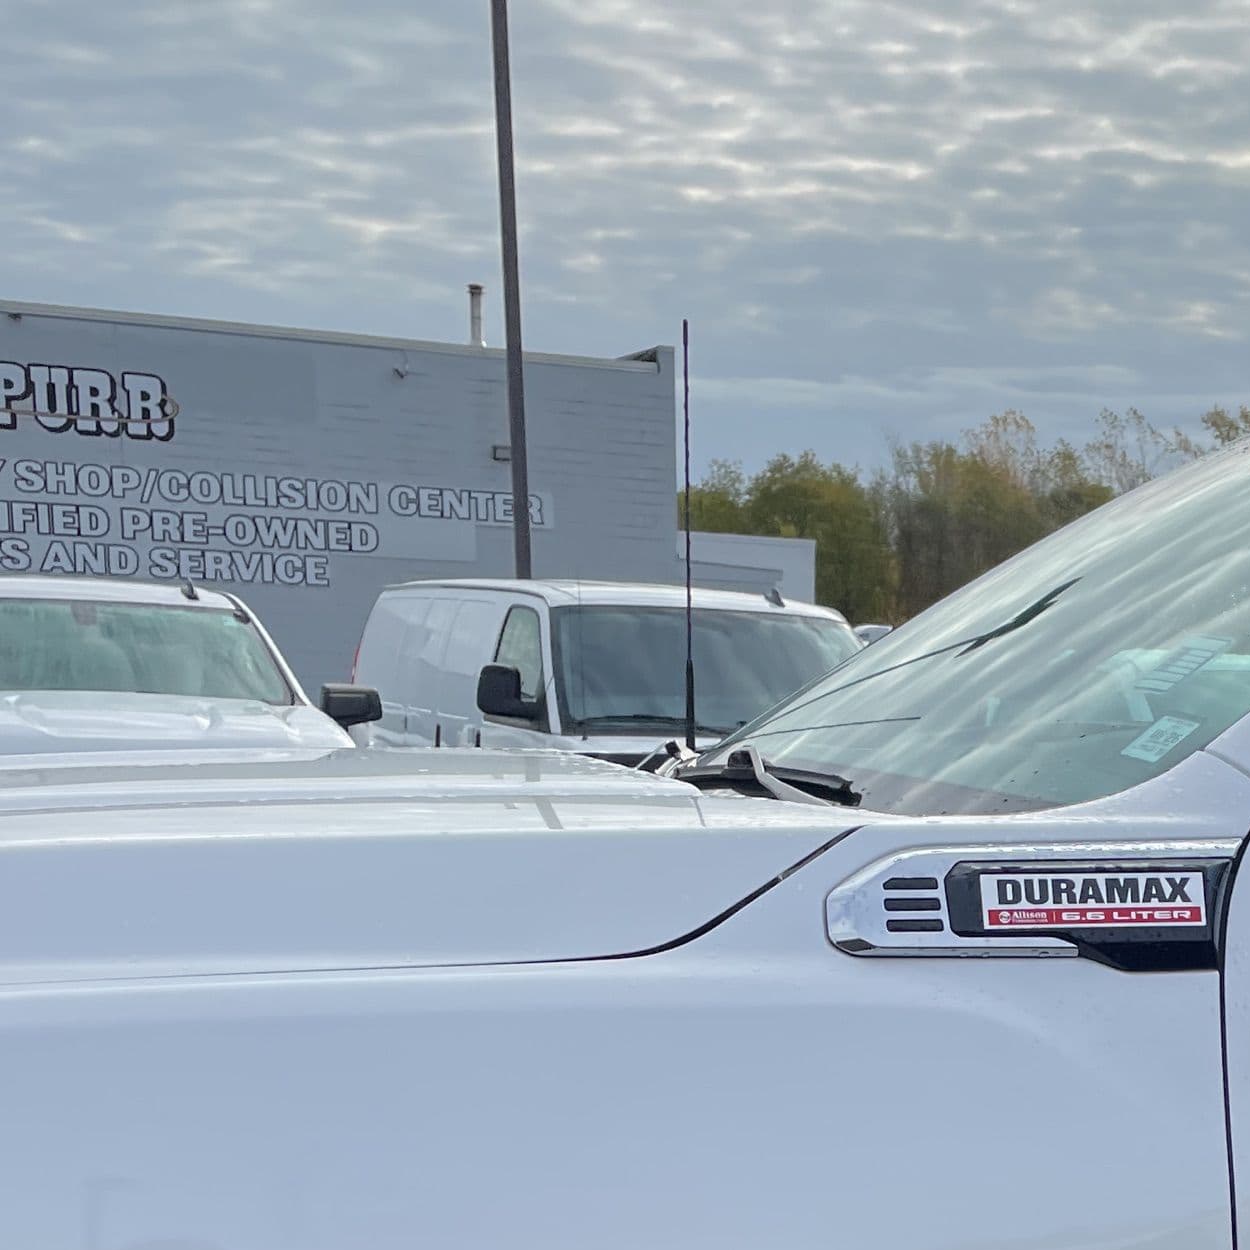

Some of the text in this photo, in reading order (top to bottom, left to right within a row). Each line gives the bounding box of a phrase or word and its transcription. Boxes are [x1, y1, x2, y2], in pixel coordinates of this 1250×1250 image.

[14, 459, 544, 525] SHOP/COLLISION CENTER
[120, 507, 379, 553] PRE-OWNED
[40, 540, 139, 576] AND
[149, 546, 329, 587] SERVICE
[996, 877, 1192, 905] DURAMAX
[1011, 910, 1191, 921] Allison 6.6 LITER
